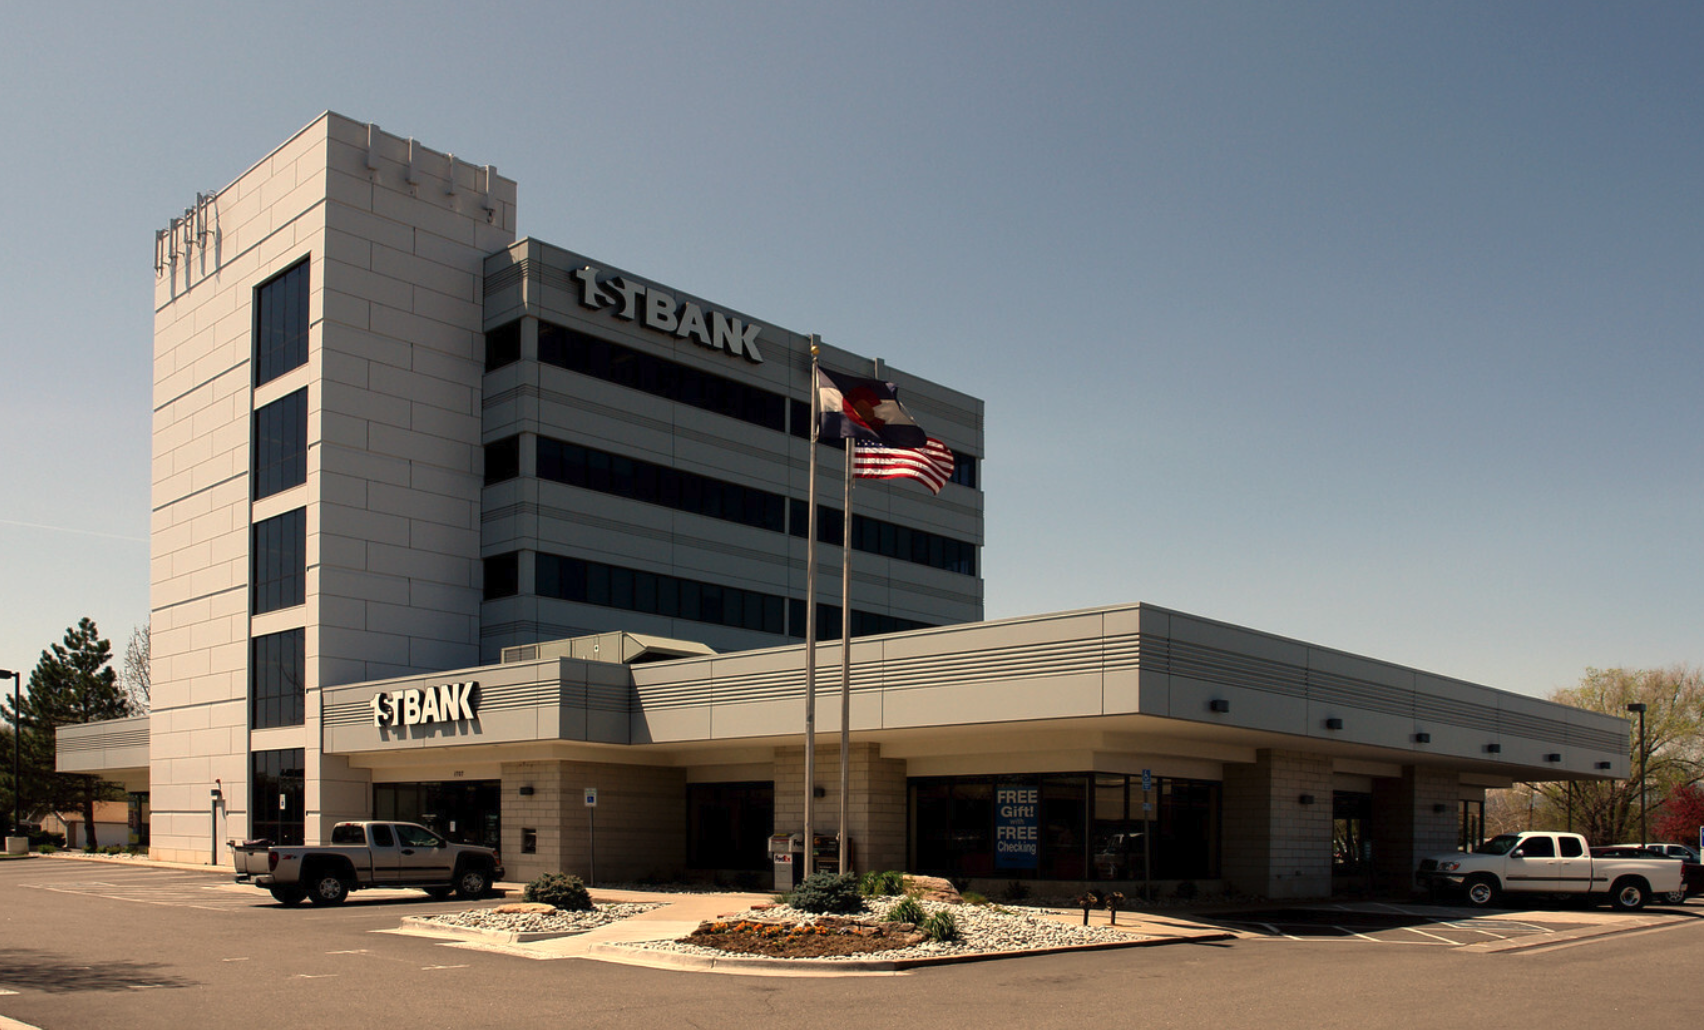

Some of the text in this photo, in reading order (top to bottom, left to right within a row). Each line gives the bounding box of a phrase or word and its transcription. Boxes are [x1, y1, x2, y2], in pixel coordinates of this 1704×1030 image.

[997, 790, 1038, 804] FREE
[997, 826, 1038, 840] FREE
[997, 841, 1037, 855] Checking
